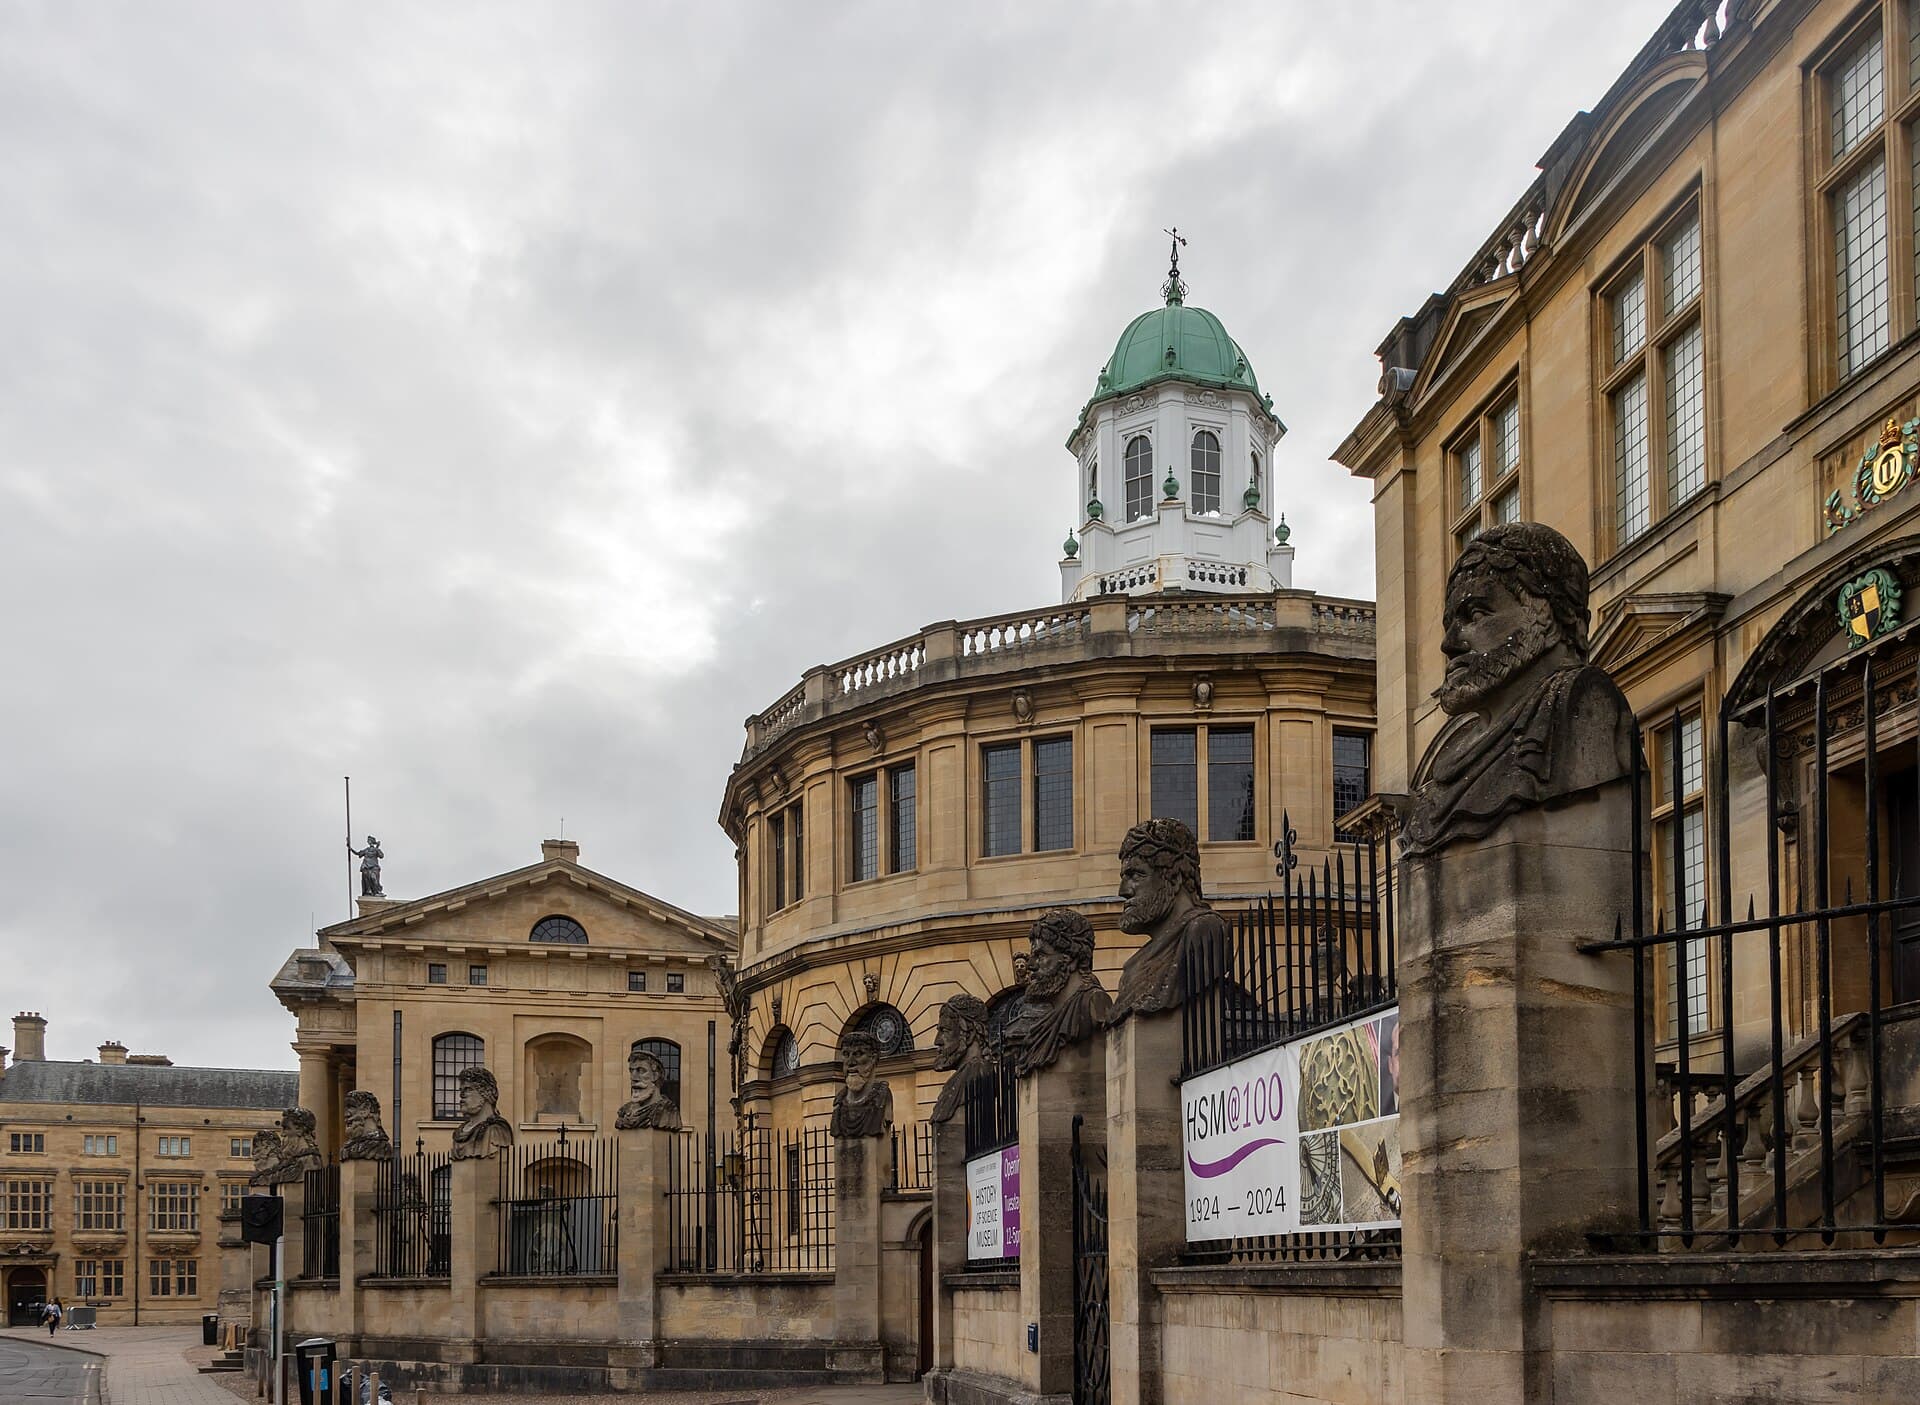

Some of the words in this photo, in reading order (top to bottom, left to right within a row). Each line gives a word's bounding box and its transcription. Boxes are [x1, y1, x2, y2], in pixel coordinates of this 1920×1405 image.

[1186, 1072, 1283, 1143] HSM@100
[975, 1184, 998, 1206] HISTORY
[1190, 1195, 1220, 1223] 1924
[1246, 1186, 1287, 1216] 2024
[976, 1211, 982, 1225] OF
[982, 1208, 998, 1224] SCIENCE
[976, 1228, 998, 1248] MUSEUM
